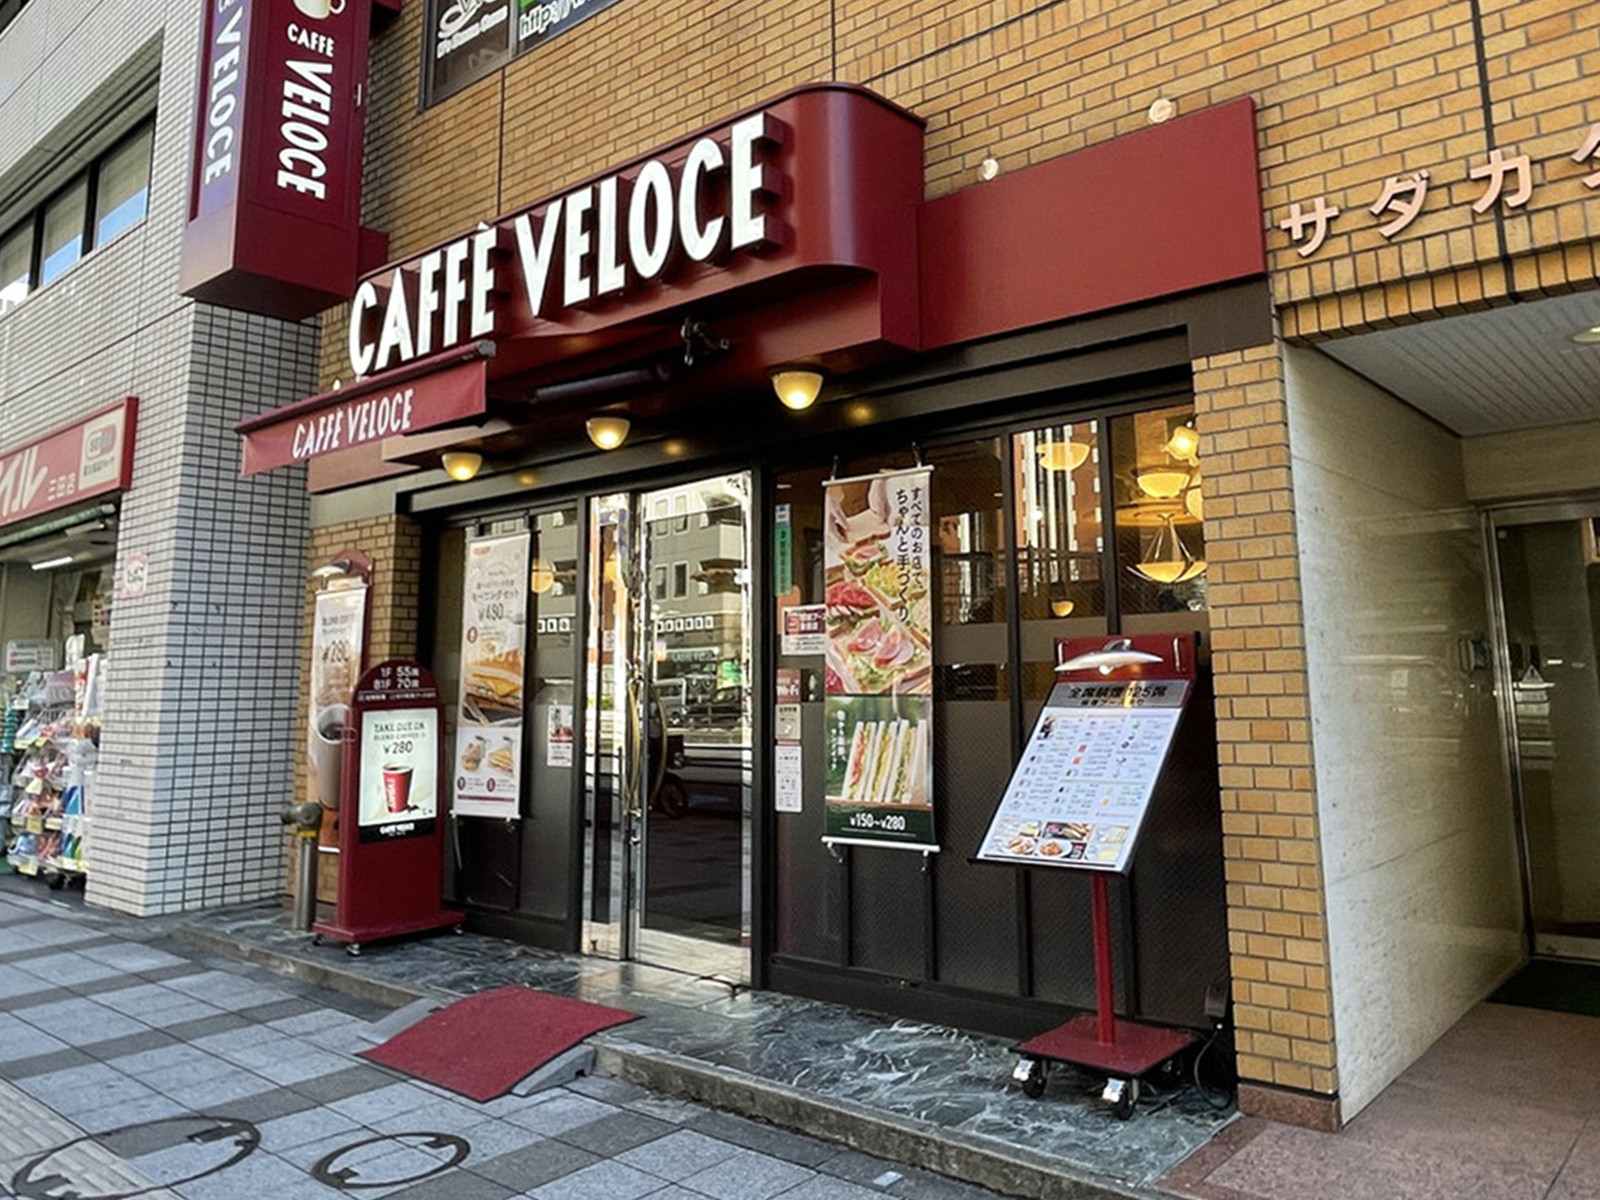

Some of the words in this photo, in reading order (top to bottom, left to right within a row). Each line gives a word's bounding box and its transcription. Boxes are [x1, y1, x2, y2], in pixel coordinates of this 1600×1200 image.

[205, 6, 243, 185] VELOCE
[277, 60, 333, 199] VELOCE
[349, 221, 497, 375] CAFFÈ
[514, 112, 765, 317] VELOCE
[348, 388, 414, 444] VELOCE
[896, 490, 911, 627] ちゃんと手づくり。
